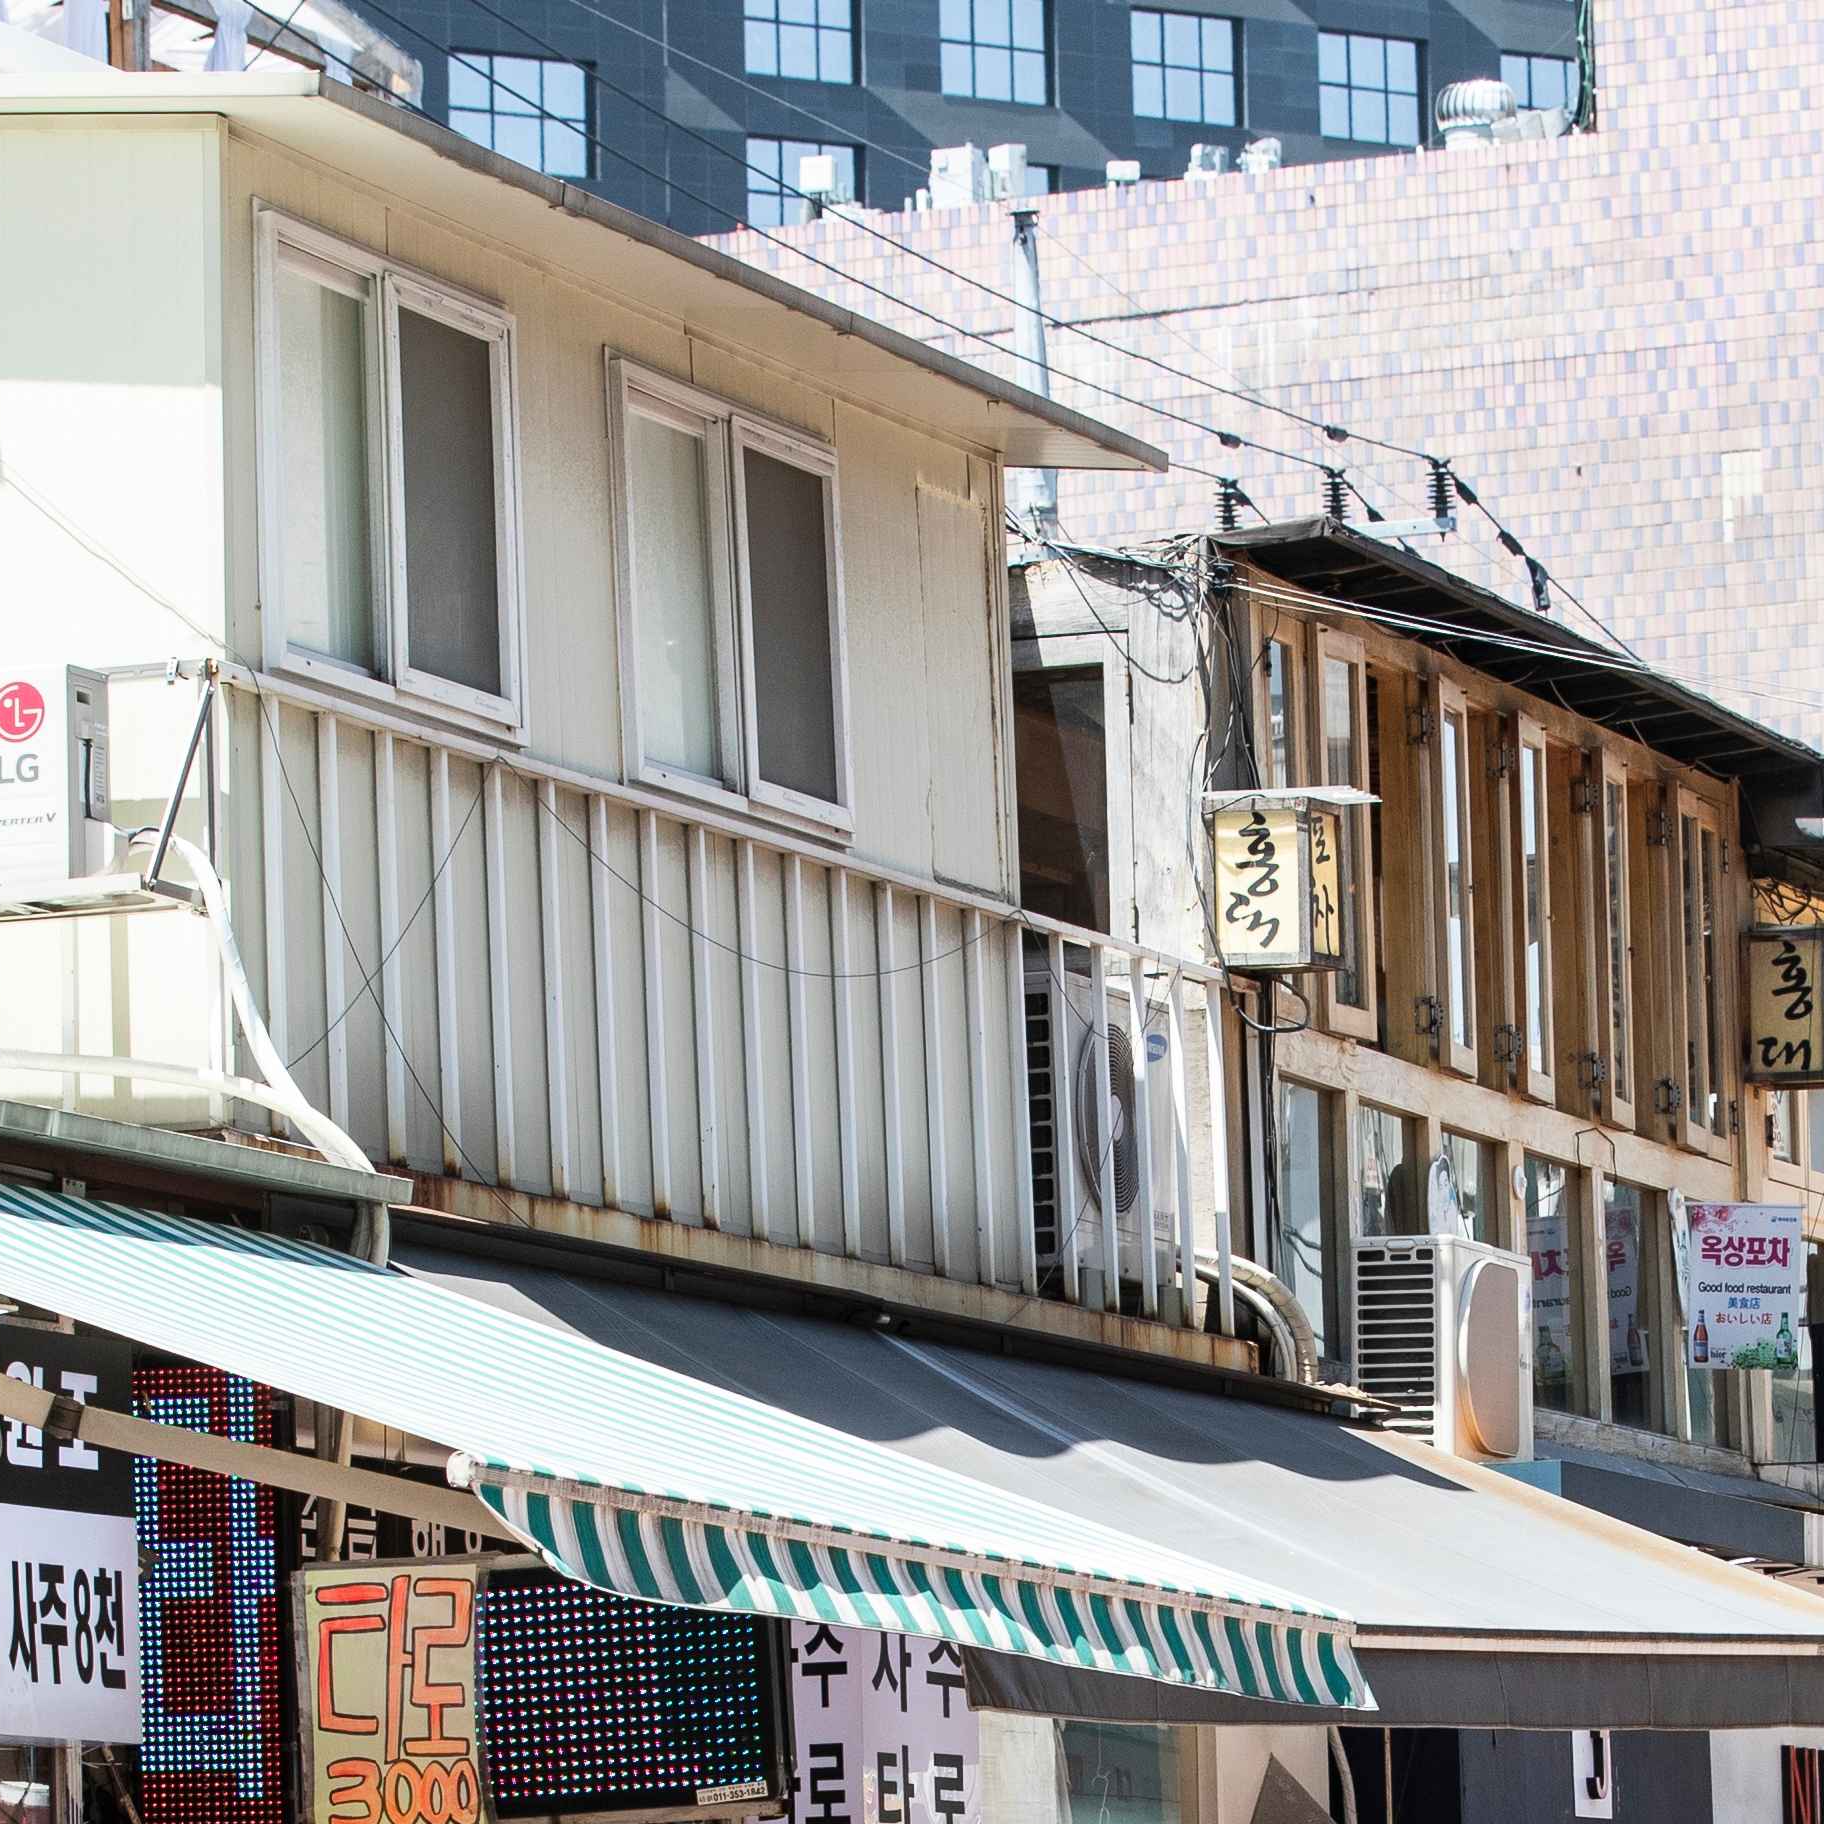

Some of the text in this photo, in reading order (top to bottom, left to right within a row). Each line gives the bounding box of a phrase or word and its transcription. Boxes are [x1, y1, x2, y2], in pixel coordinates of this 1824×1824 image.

[1226, 811, 1280, 949] 홍대
[1757, 939, 1814, 1071] 홍대
[1701, 1235, 1791, 1268] 옥상포차
[1698, 1281, 1792, 1295] Good food restaurant
[1727, 1296, 1761, 1310] 美食店
[1715, 1311, 1774, 1325] おいしい店
[316, 1573, 473, 1764] 타로
